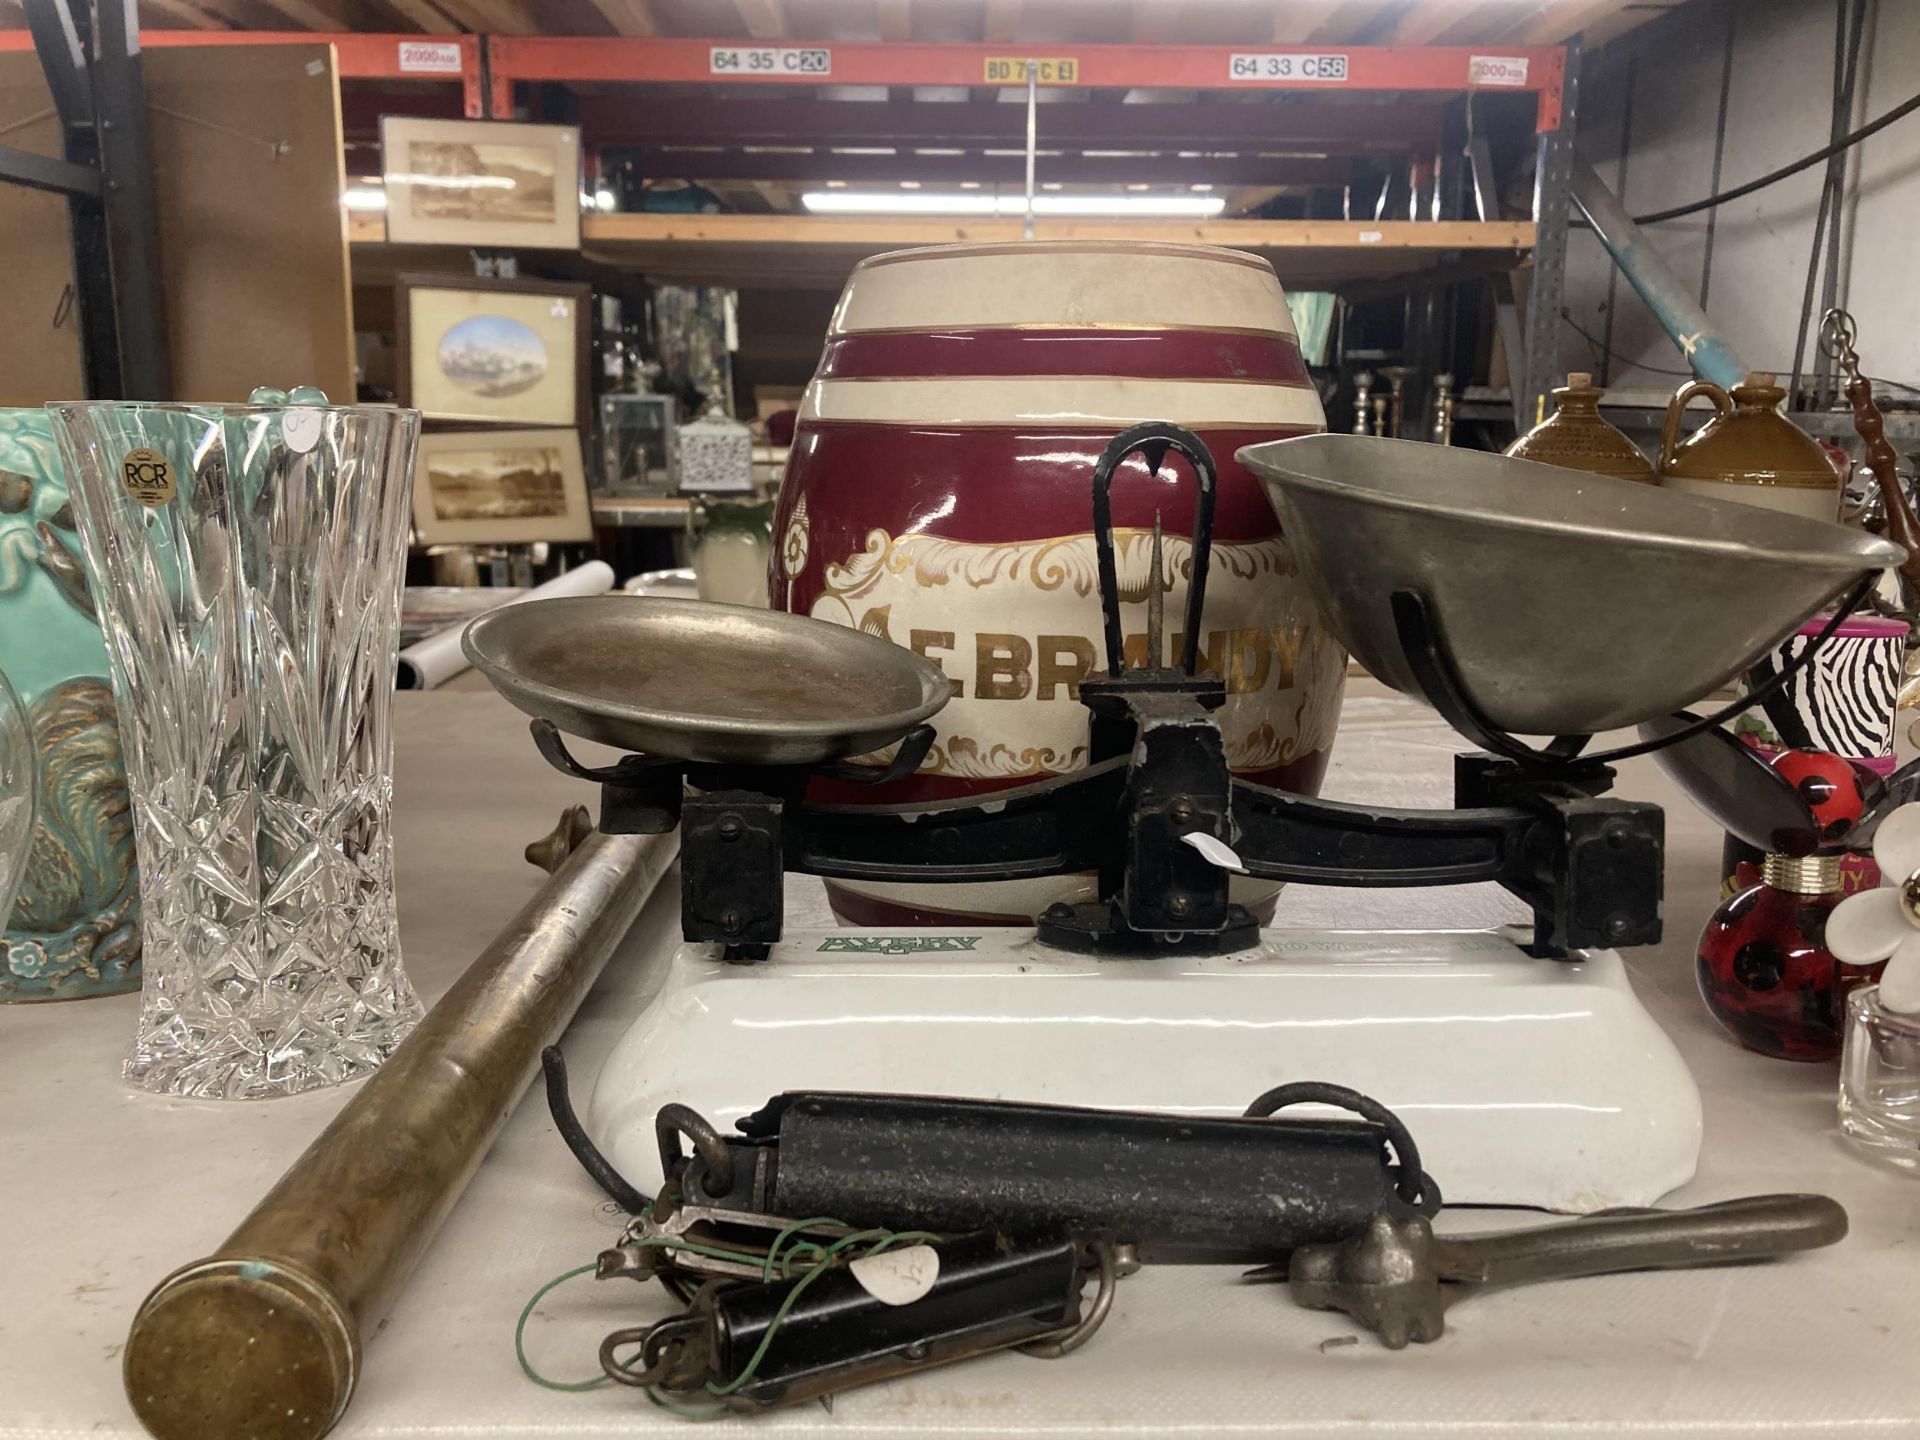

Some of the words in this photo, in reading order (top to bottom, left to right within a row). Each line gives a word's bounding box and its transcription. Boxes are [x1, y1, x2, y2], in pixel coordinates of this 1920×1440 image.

[713, 51, 739, 70] 64
[748, 51, 774, 70] 35
[1233, 58, 1257, 76] 64
[1267, 58, 1292, 76] 33
[124, 462, 169, 485] RCR
[816, 936, 983, 952] AVERY
